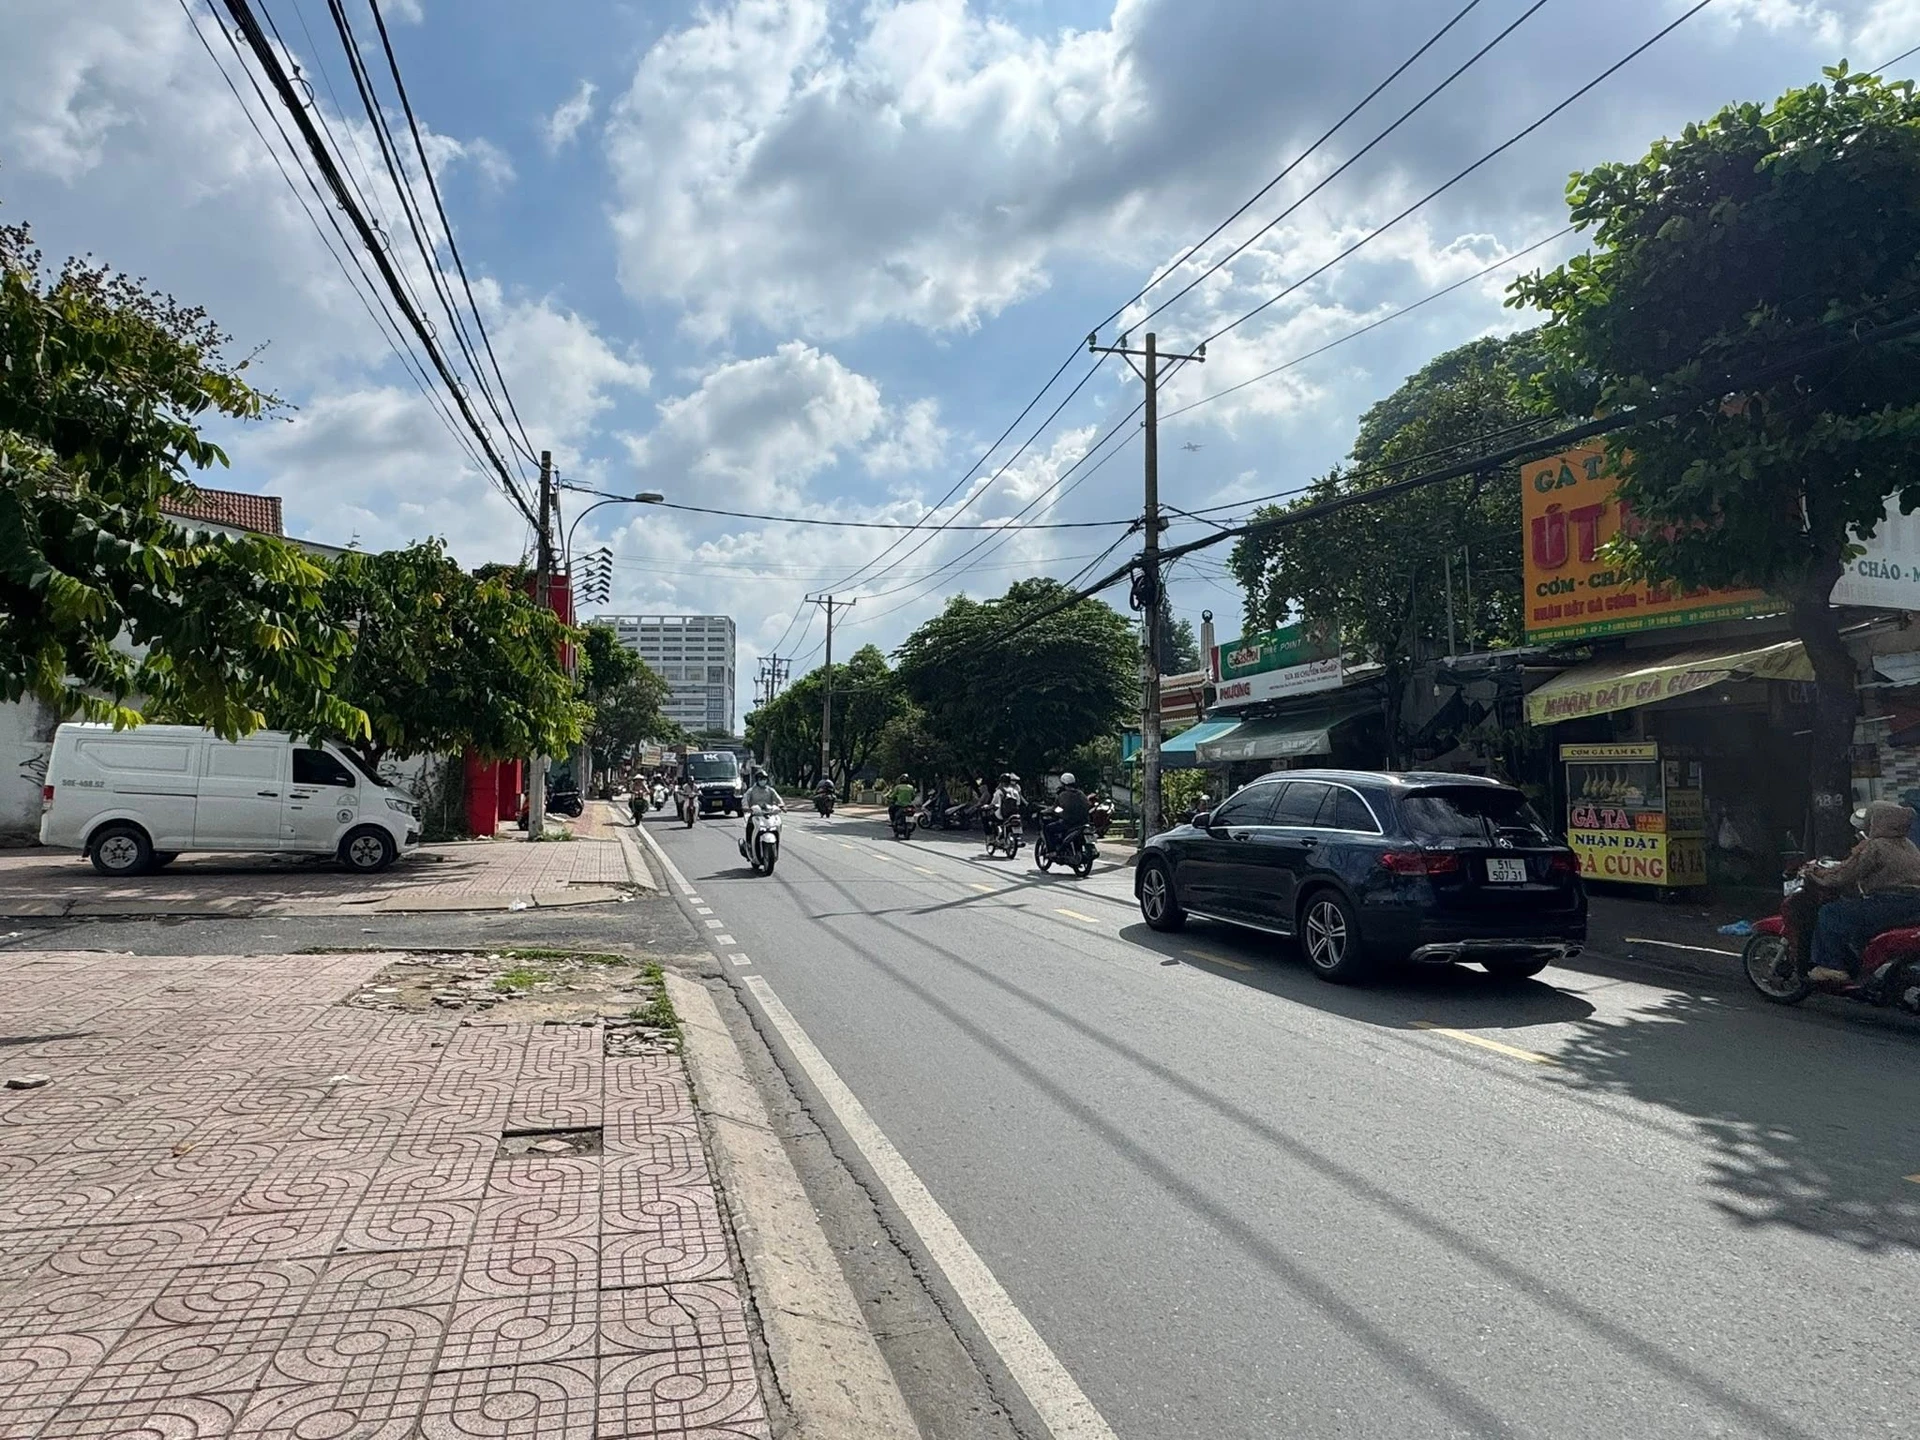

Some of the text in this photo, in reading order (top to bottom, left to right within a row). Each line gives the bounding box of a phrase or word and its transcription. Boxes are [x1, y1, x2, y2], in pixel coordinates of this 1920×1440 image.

[1534, 458, 1577, 493] GÀ
[1536, 576, 1575, 597] CƠM
[1572, 804, 1600, 828] GÀ
[1601, 809, 1631, 829] TA
[1575, 834, 1659, 851] NHẬN ĐẶT
[1497, 860, 1515, 870] 51L
[1604, 850, 1665, 878] CÚNG
